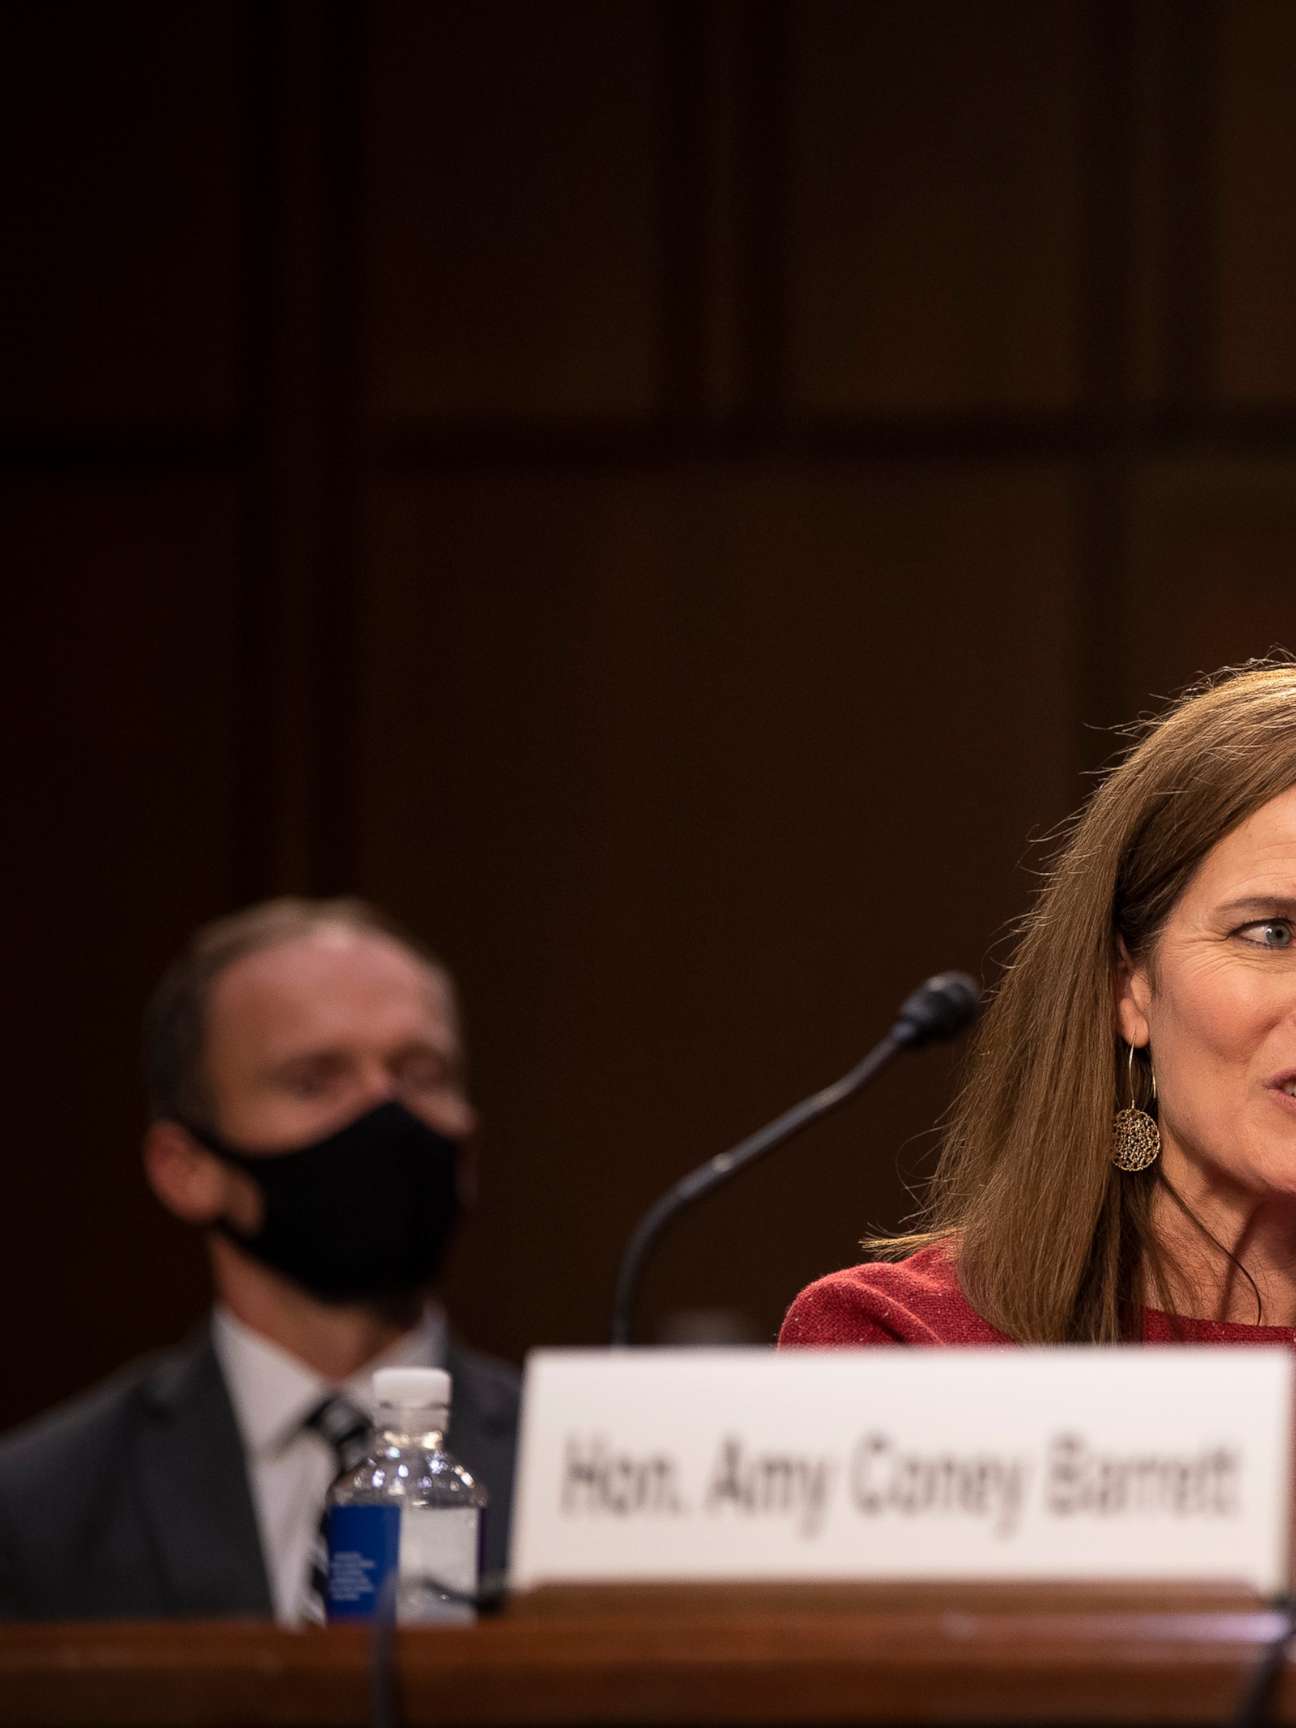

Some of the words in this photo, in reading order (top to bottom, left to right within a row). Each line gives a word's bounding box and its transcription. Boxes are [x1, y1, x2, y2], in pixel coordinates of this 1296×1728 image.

[562, 1434, 682, 1515] Hon.
[706, 1437, 829, 1535] Amy
[851, 1435, 1026, 1535] Coney
[1048, 1438, 1239, 1516] Barrett
